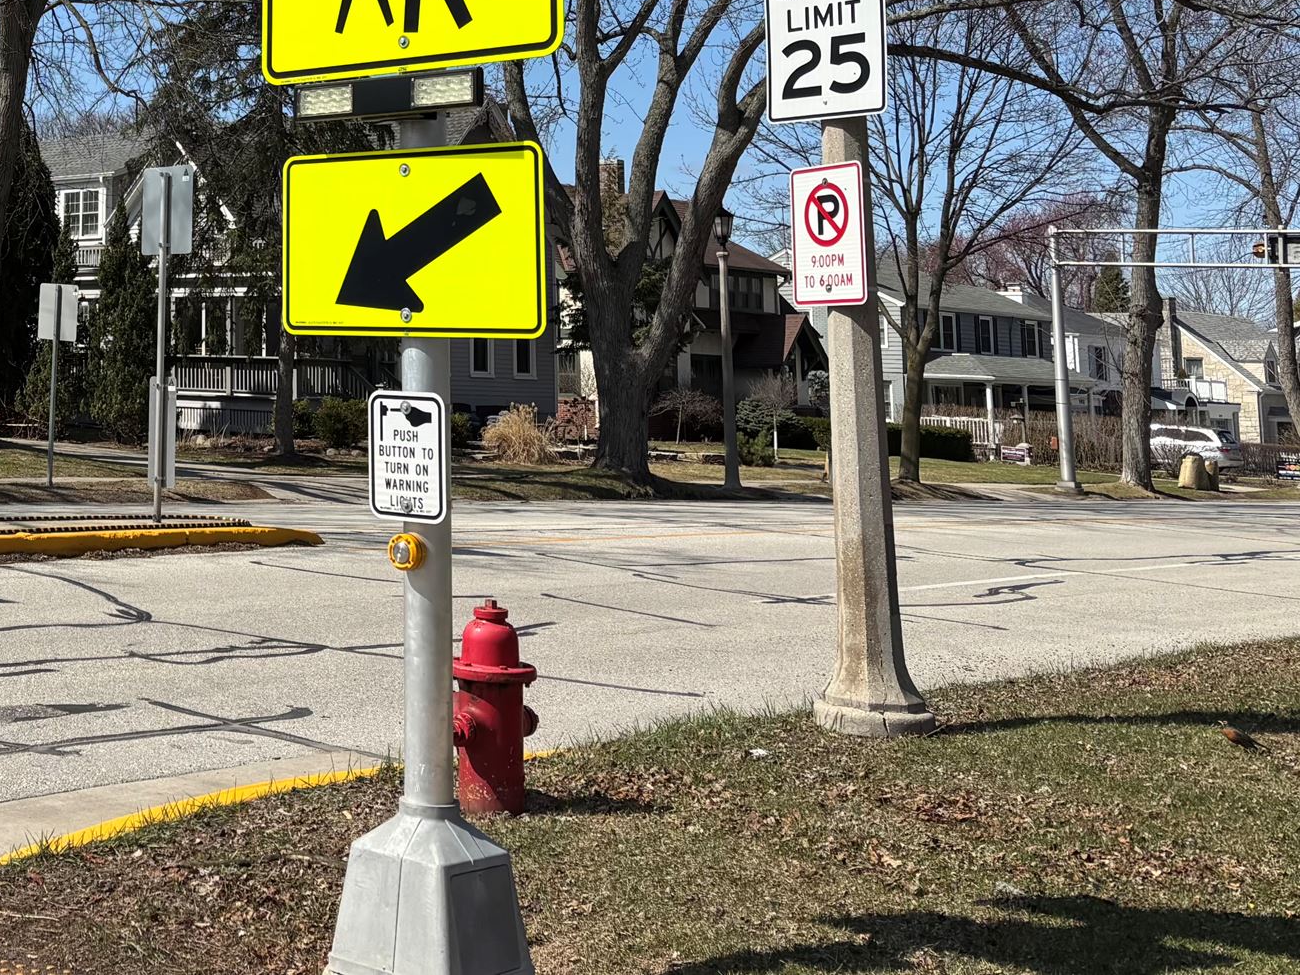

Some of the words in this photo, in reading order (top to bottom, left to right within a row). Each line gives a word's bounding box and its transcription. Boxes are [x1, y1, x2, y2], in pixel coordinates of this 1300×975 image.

[781, 32, 871, 101] 25
[804, 275, 815, 289] TO
[393, 429, 419, 443] PUSH
[378, 444, 416, 459] BUTTON
[421, 447, 434, 461] TO
[384, 461, 409, 475] TURN
[415, 464, 429, 476] ON
[384, 478, 429, 494] WARNING
[390, 494, 424, 510] LITS
